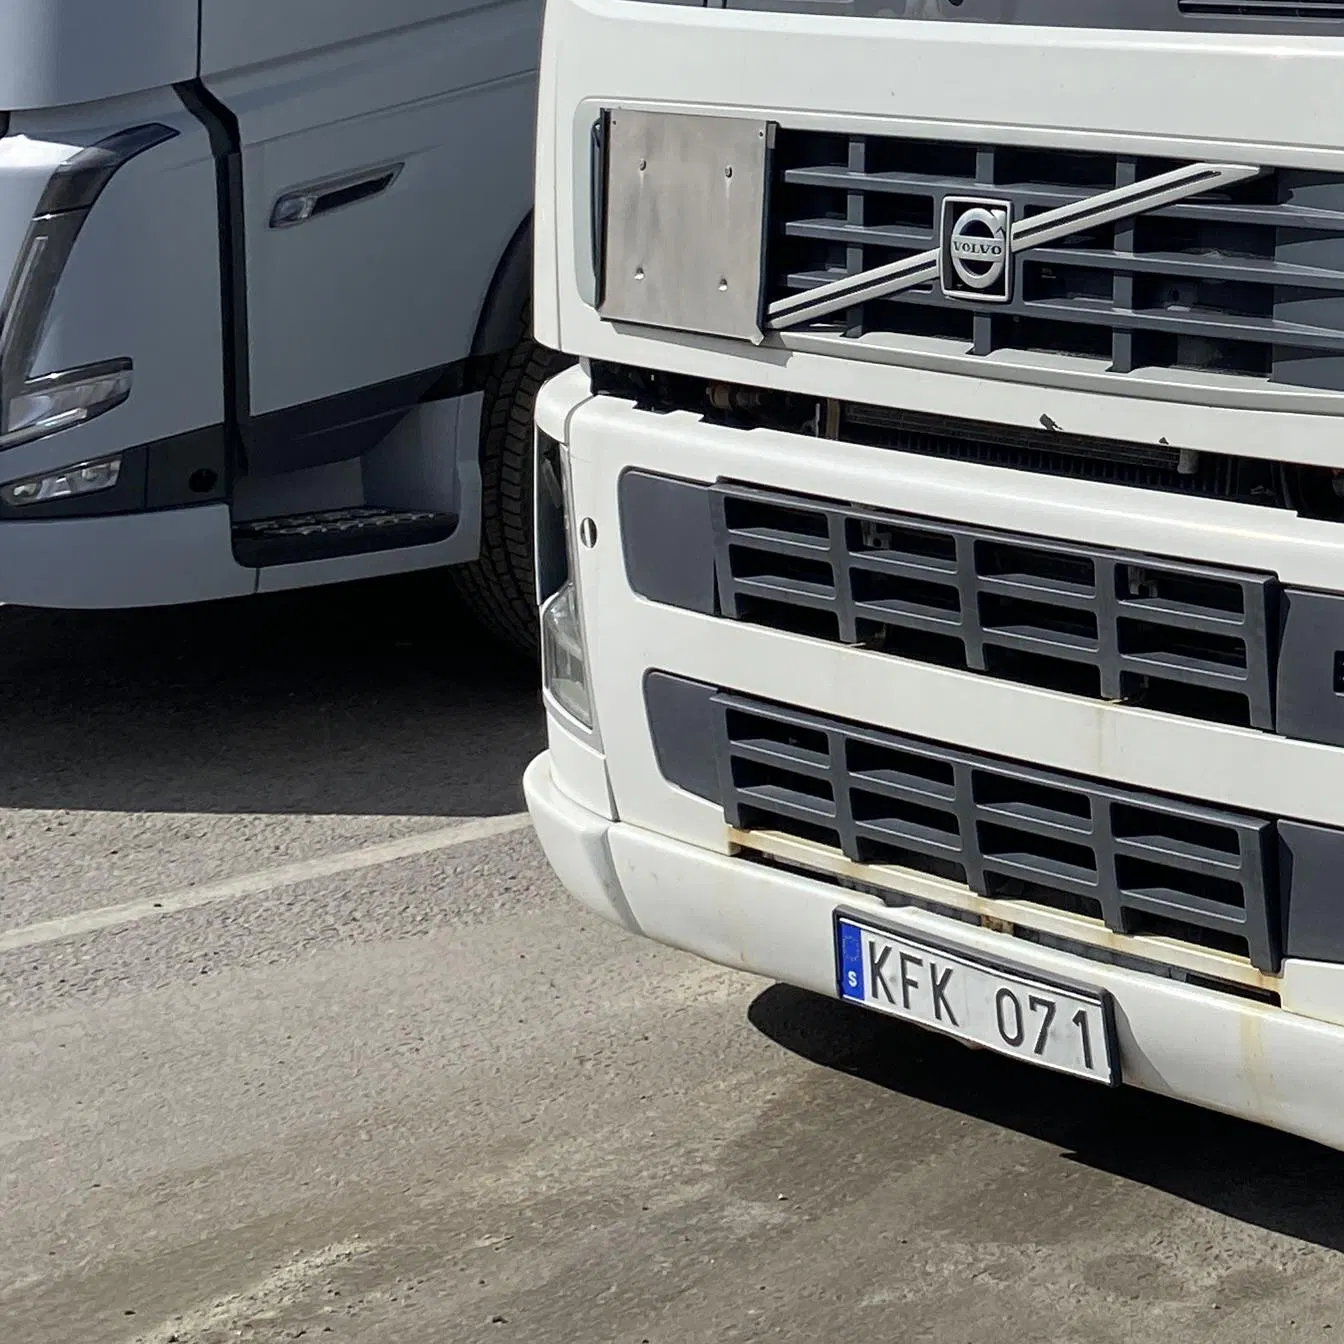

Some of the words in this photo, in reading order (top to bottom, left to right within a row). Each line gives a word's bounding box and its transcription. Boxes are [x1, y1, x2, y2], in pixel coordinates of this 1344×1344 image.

[953, 241, 1002, 255] VOLVO
[848, 970, 857, 988] S
[868, 940, 960, 1028] KFK
[995, 987, 1095, 1071] 071
